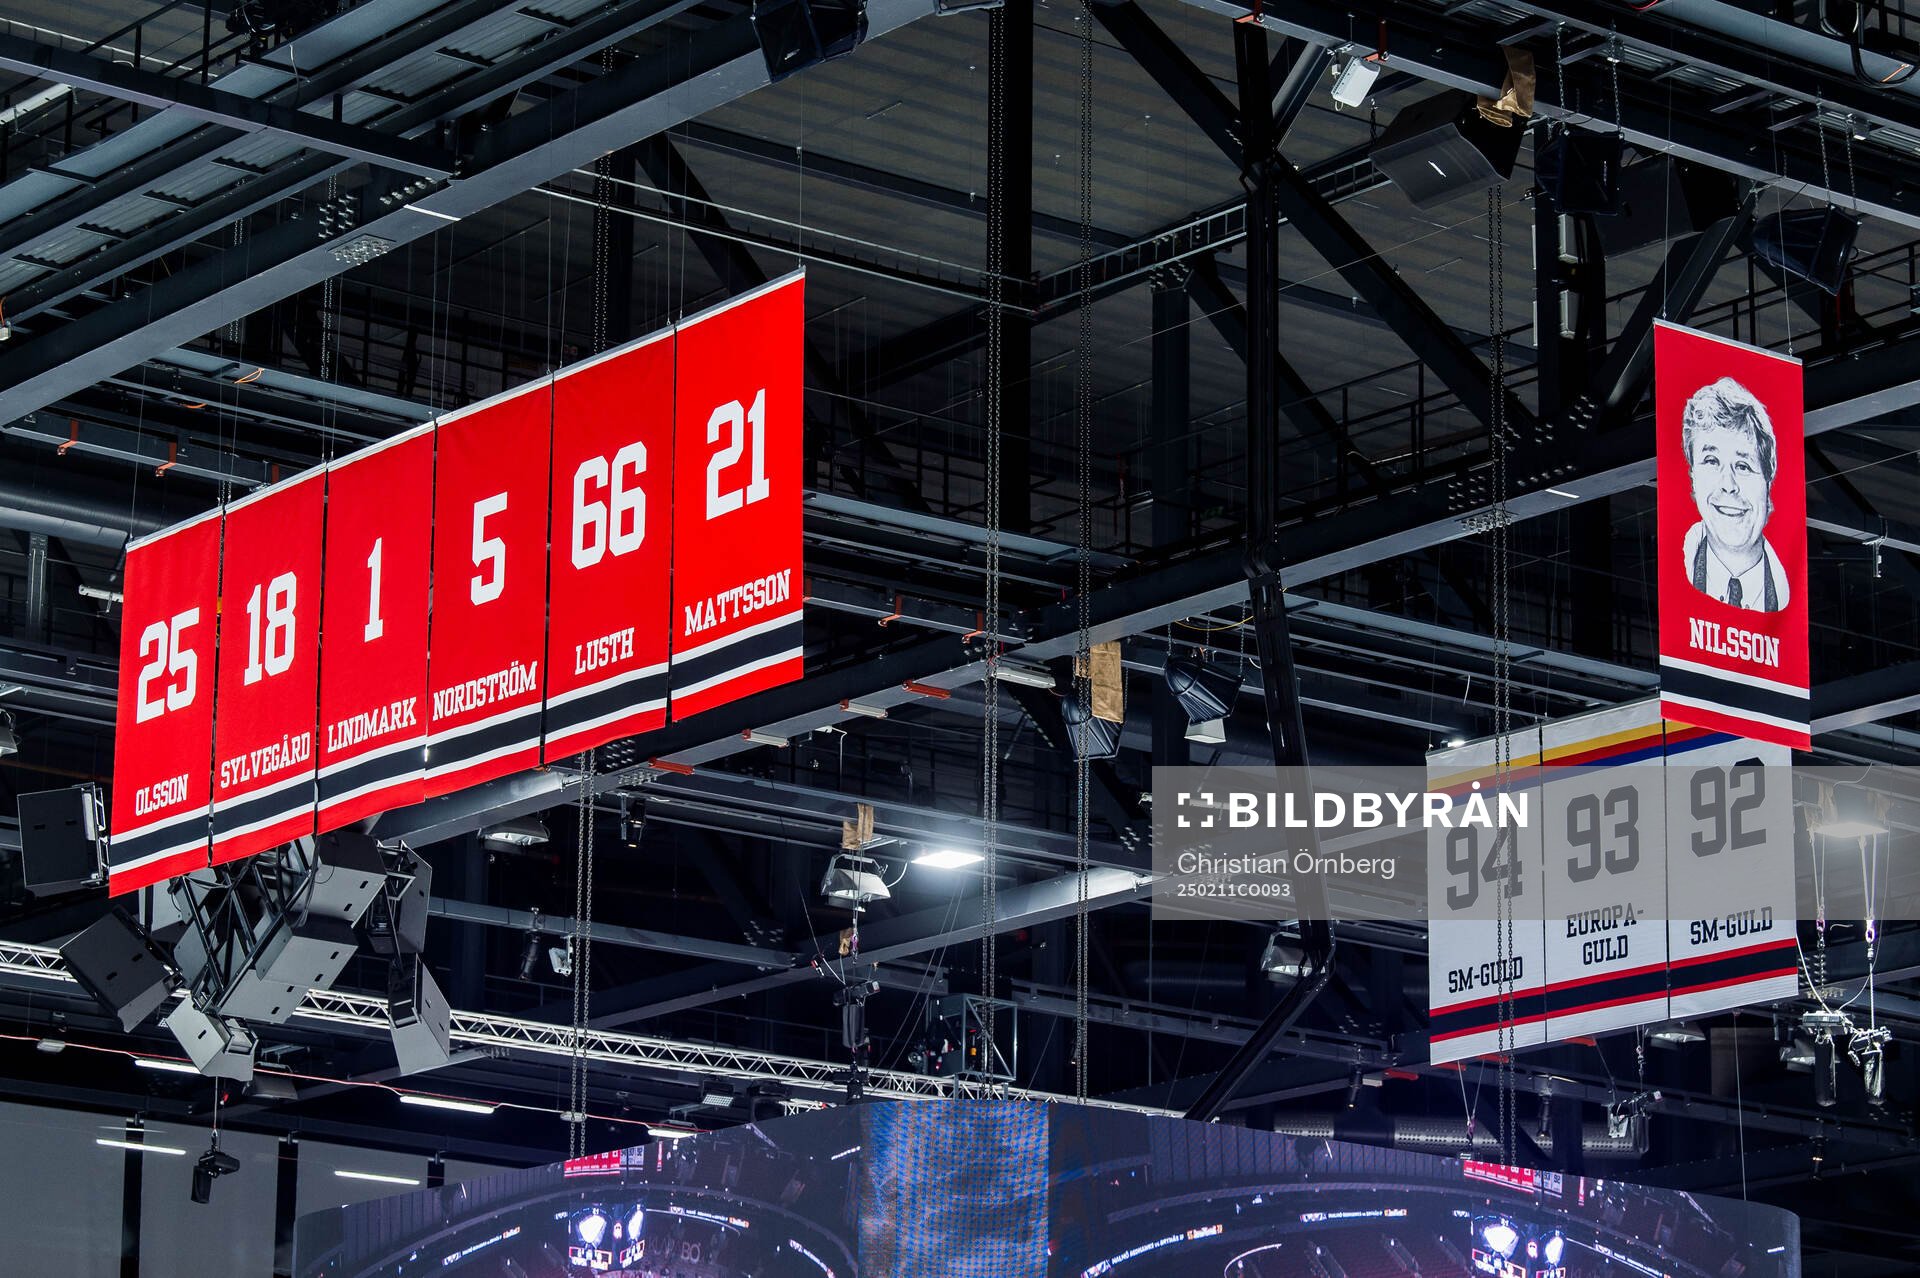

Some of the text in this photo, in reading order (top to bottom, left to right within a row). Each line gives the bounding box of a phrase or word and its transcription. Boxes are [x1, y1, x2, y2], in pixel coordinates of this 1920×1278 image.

[707, 389, 769, 520] 21
[572, 441, 646, 569] 66
[471, 492, 507, 605] 5
[365, 538, 383, 642] 1
[685, 569, 790, 636] MATTSSON
[244, 572, 296, 685] 18
[575, 628, 634, 674] LUSTH
[1690, 618, 1779, 667] NILSSON
[137, 607, 199, 723] 25
[433, 661, 537, 718] NORDSTRÖM
[328, 697, 416, 753] LINDMARK
[221, 732, 310, 788] SYLVEGÅRD
[136, 774, 188, 816] OLSSON
[1691, 757, 1766, 857] 92
[1446, 816, 1523, 911] 94
[1567, 785, 1639, 882] 93
[1567, 905, 1643, 938] EUROPA-
[1583, 935, 1628, 965] GULD
[1691, 907, 1772, 945] SM-GULD
[1448, 955, 1523, 995] SM-GULD
